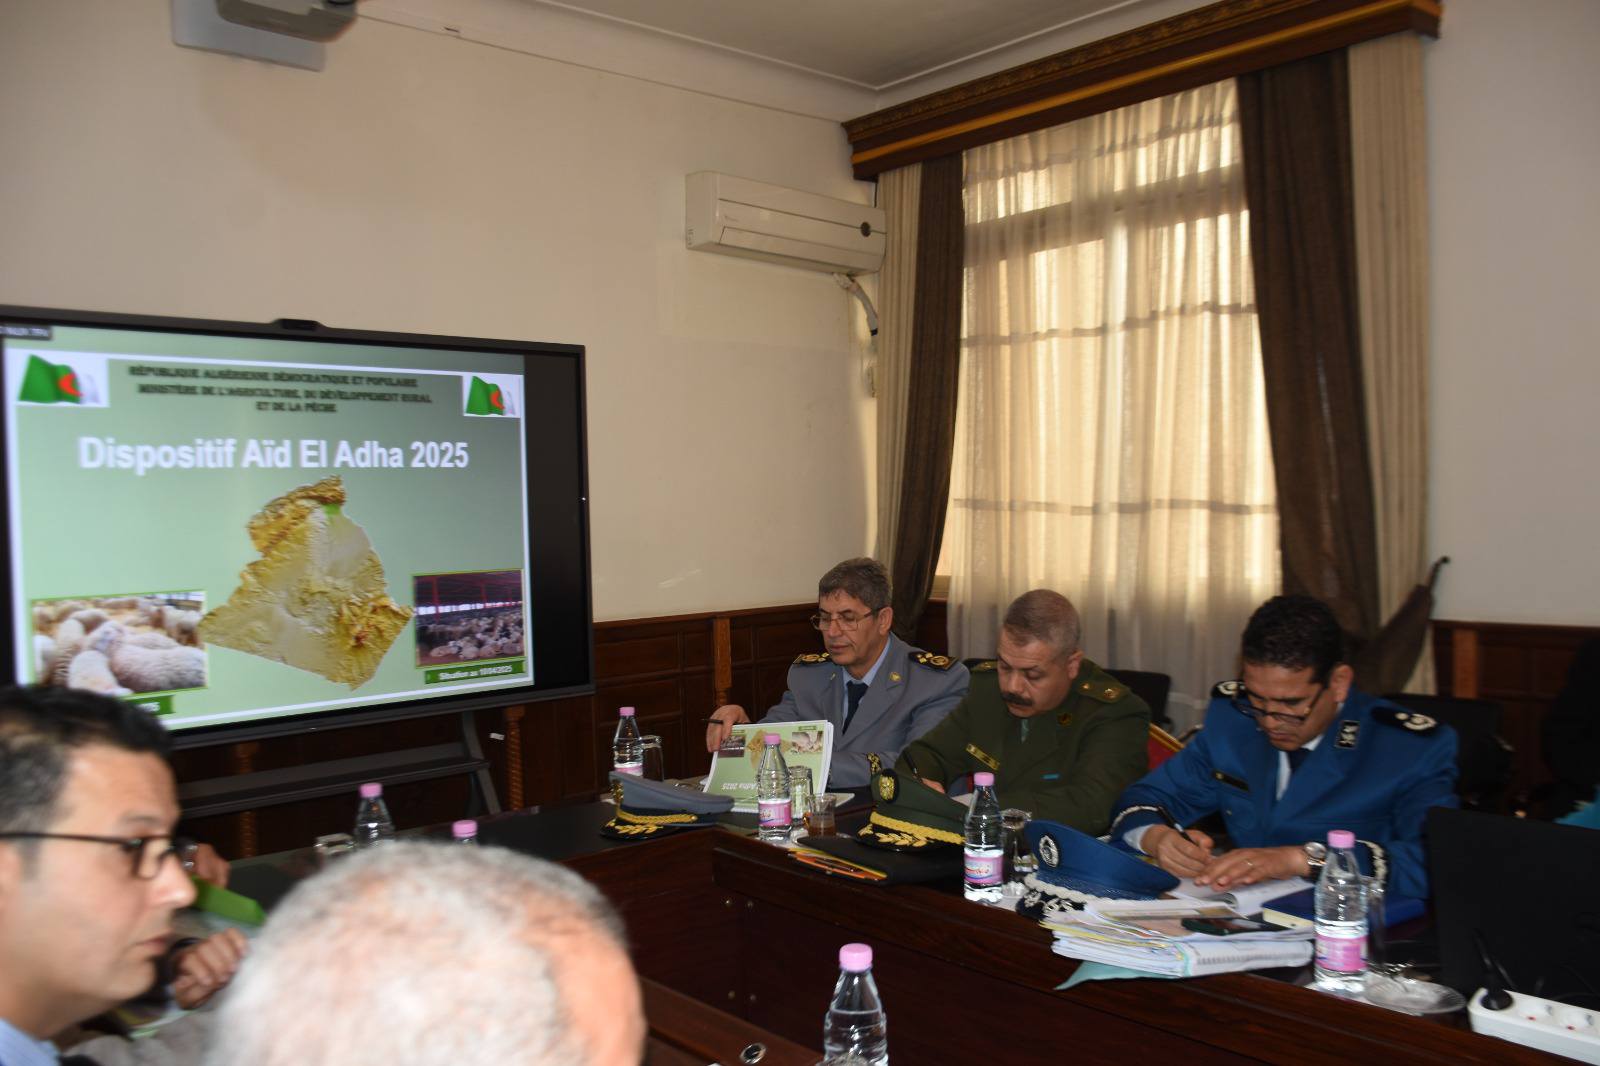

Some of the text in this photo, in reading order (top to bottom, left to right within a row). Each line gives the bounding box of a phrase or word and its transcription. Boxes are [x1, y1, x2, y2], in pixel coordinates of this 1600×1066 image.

[78, 436, 470, 475] Dispositif Aïd El Adha 2025
